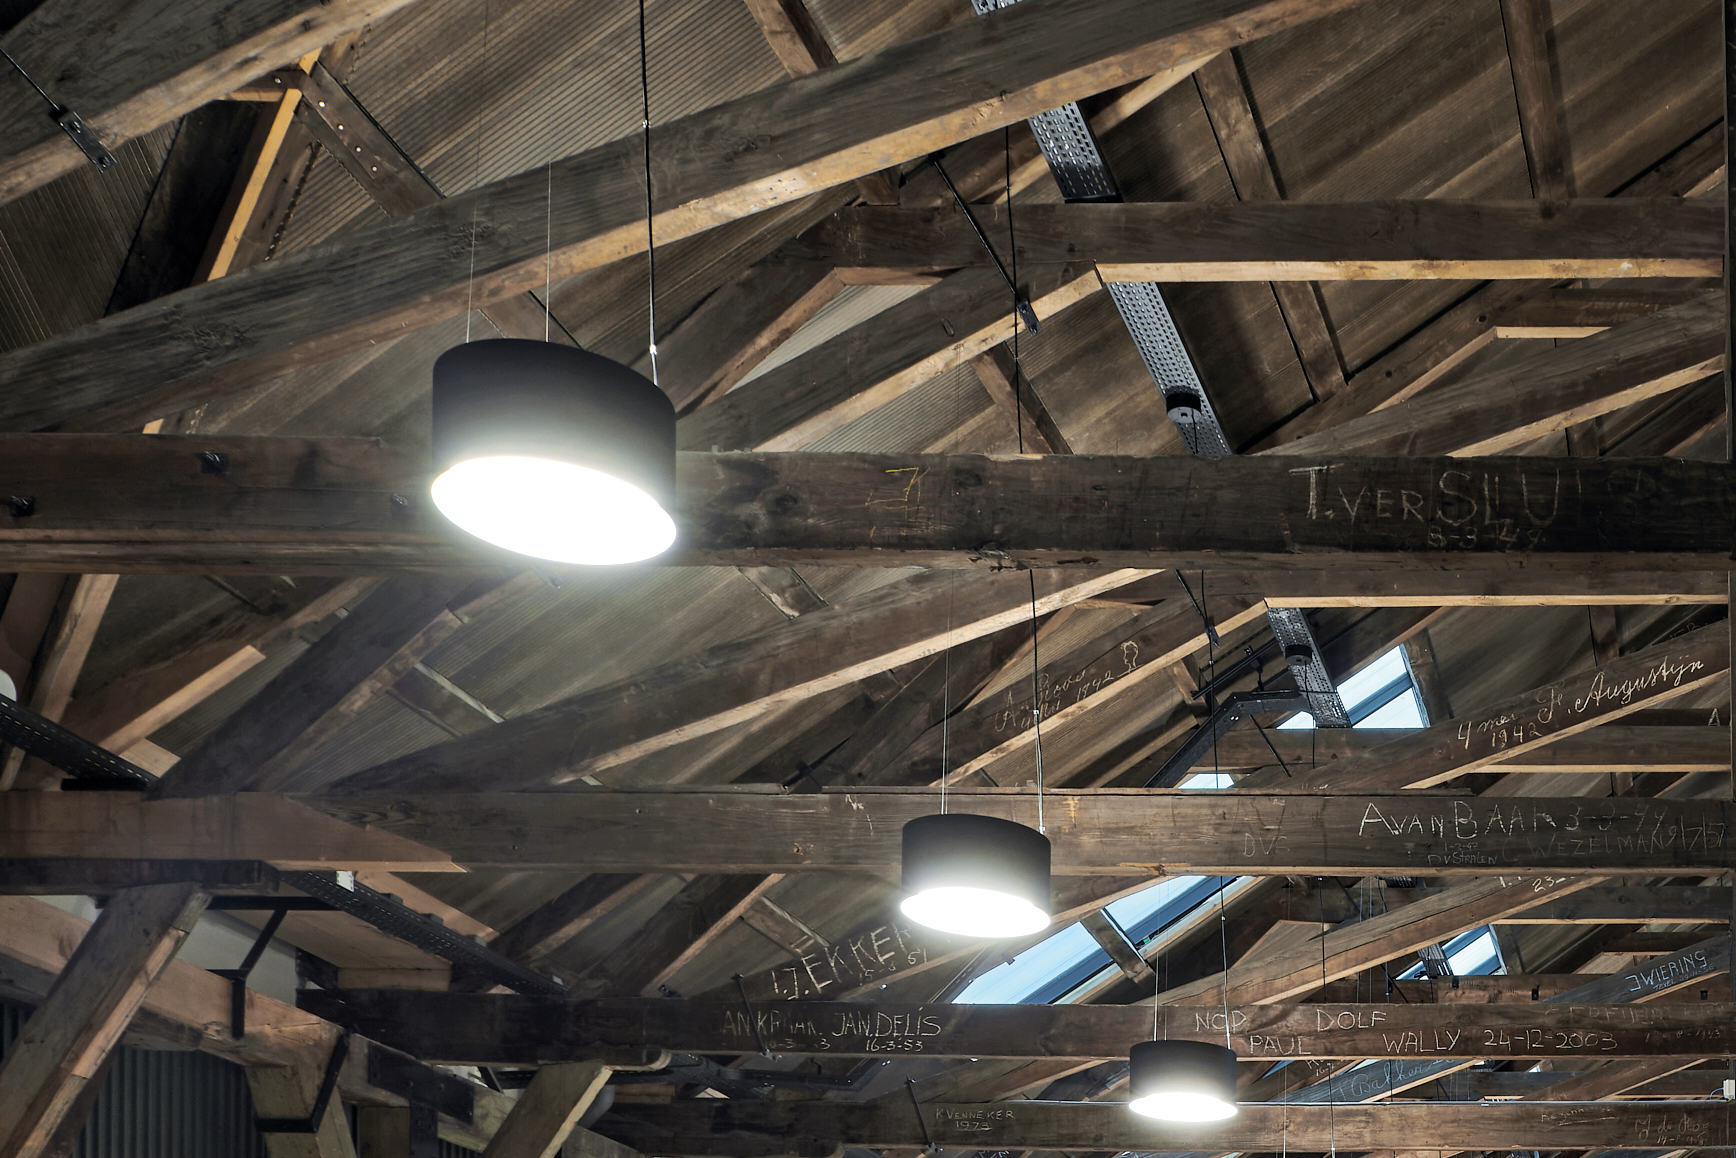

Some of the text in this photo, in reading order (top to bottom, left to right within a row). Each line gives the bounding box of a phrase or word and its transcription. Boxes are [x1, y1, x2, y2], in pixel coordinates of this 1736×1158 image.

[1456, 720, 1472, 751] 4
[1490, 721, 1544, 749] 1942
[1315, 1008, 1387, 1034] DOLF
[865, 1038, 924, 1052] 16-3-53
[1249, 1028, 1618, 1056] PAUL WALLY 24-12-2003
[945, 1107, 1016, 1121] VENNEKER
[955, 1120, 993, 1132] 1973
